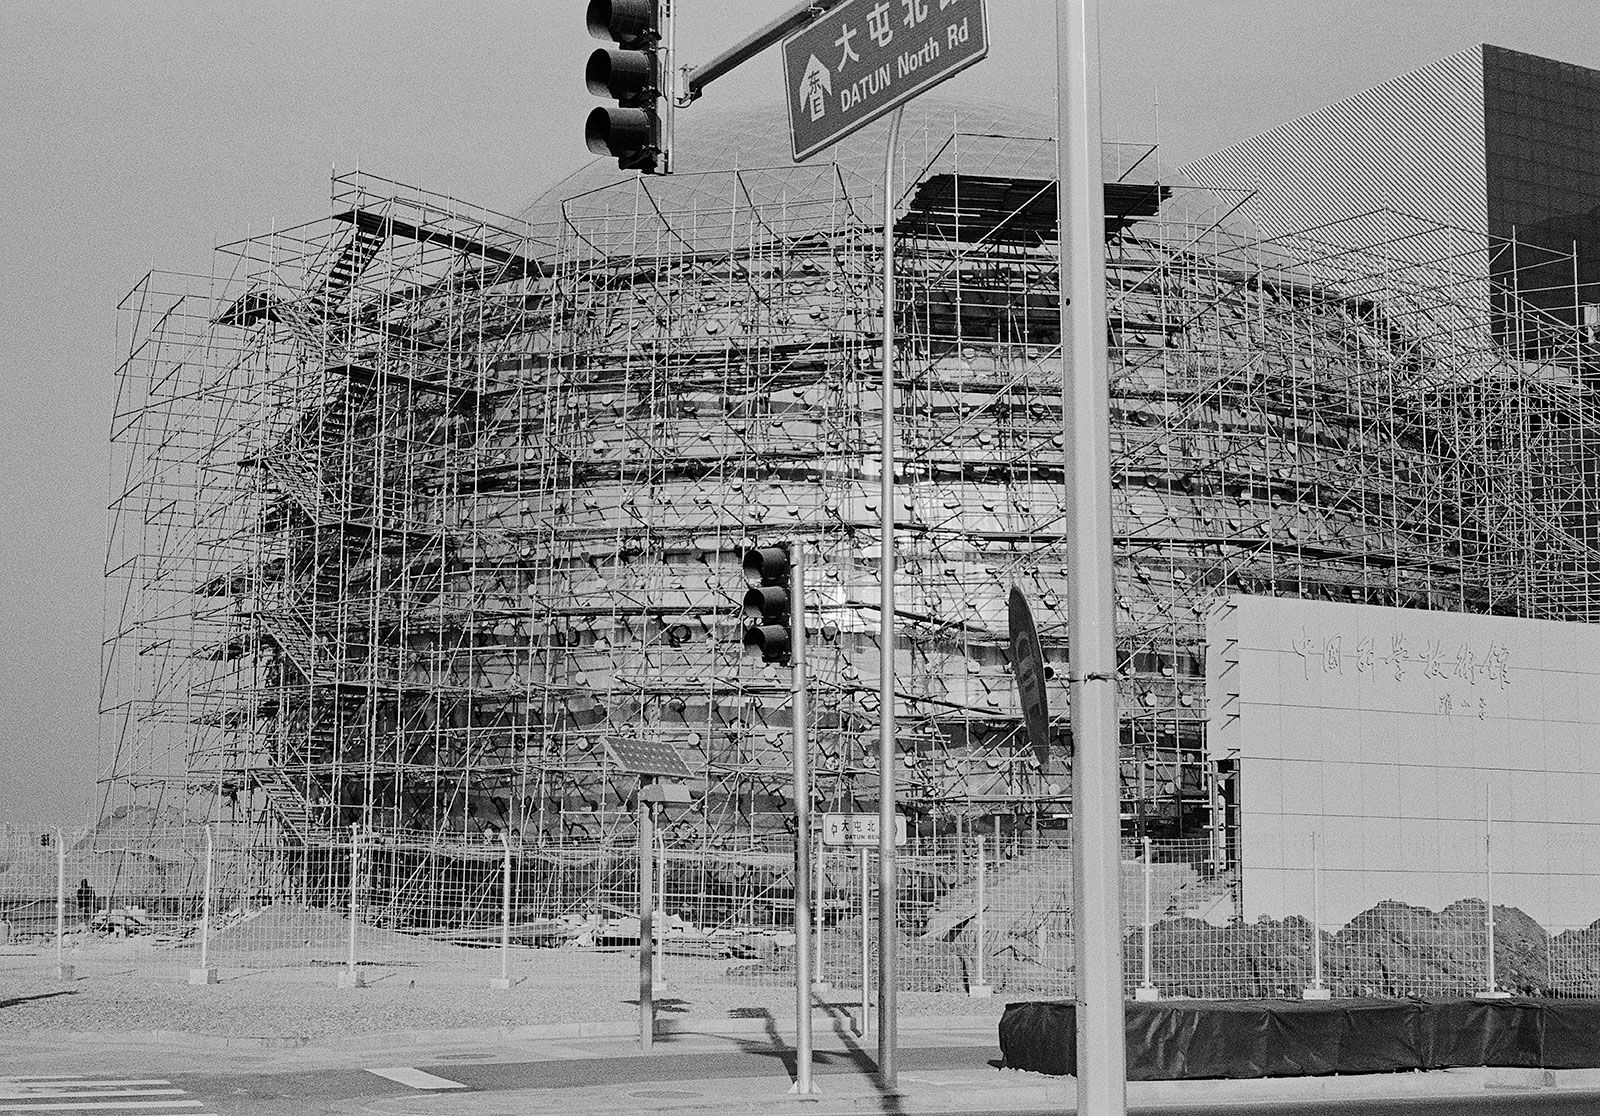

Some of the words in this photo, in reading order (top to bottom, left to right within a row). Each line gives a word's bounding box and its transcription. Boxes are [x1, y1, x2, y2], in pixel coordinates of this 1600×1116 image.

[835, 0, 958, 72] 大屯北
[840, 63, 890, 113] DATUN
[897, 36, 940, 79] North
[947, 17, 969, 50] Rd
[813, 97, 823, 115] E
